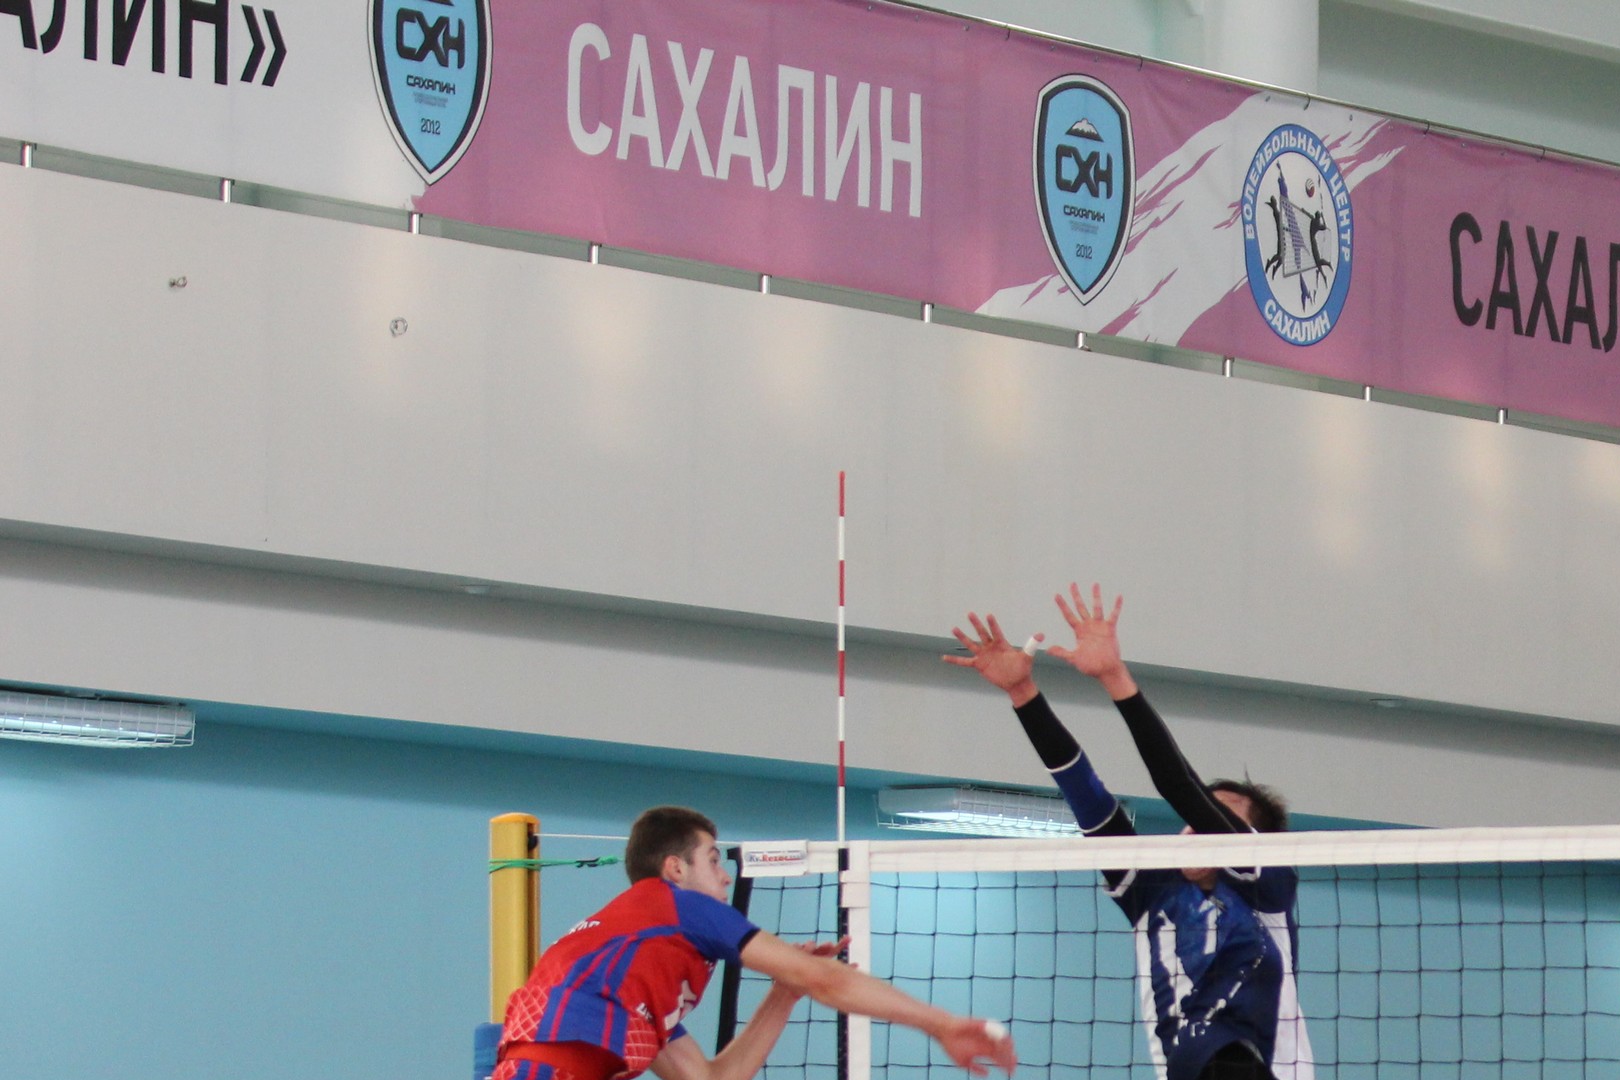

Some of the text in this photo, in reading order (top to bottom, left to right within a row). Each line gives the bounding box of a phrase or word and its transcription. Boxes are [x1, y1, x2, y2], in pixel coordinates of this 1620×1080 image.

[406, 75, 456, 95] САХАЛИН
[420, 118, 441, 135] 2012
[567, 22, 922, 218] САХАЛИН
[1243, 129, 1351, 263] ВОЛЕЙБОЛЬНЫЙ ЦЕНТР
[1063, 205, 1106, 222] САХАЛИН
[1076, 244, 1093, 259] 2012
[1264, 298, 1332, 343] САХАЛИН
